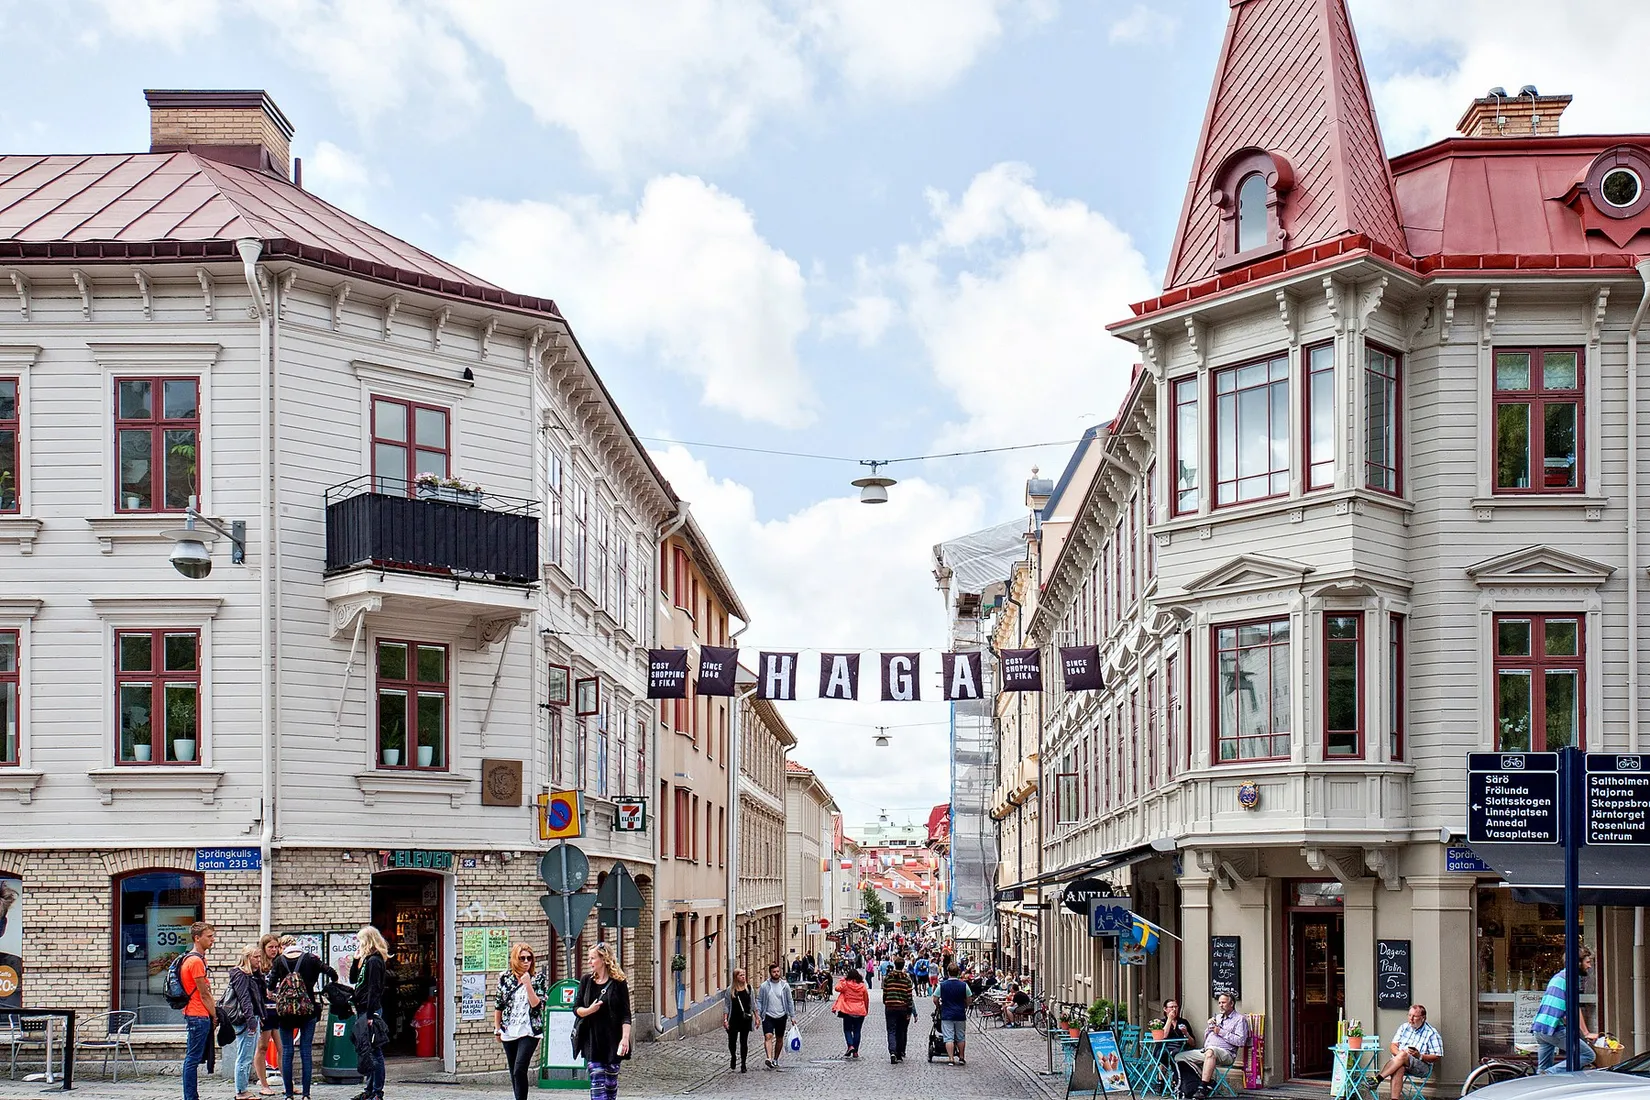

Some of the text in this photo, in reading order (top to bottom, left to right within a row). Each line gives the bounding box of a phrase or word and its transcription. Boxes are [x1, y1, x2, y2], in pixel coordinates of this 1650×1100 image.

[651, 662, 669, 670] COSY
[702, 662, 722, 670] SINCE
[1006, 664, 1040, 672] SHOPPING
[1067, 666, 1086, 675] 1648
[701, 670, 719, 678] 1648
[658, 679, 676, 687] FIKA
[1485, 775, 1510, 784] Särö
[1591, 777, 1649, 786] Saltholmen
[1485, 786, 1529, 794] Frölunda
[1591, 788, 1634, 798] Majorna
[1485, 797, 1551, 808] Slottsskogen
[1485, 808, 1548, 818] Linnéplatsen
[1591, 810, 1645, 820] Järntorget
[1485, 818, 1527, 827] Annedal
[1591, 821, 1645, 830] Rosenlund
[1485, 830, 1549, 840] Vasaplatsen
[1591, 832, 1632, 840] Centrum
[198, 861, 224, 870] gatan
[1449, 862, 1474, 870] gatan
[1066, 891, 1110, 902] ANTIK
[1378, 942, 1407, 960] Dagens
[1386, 976, 1406, 990] 5:-
